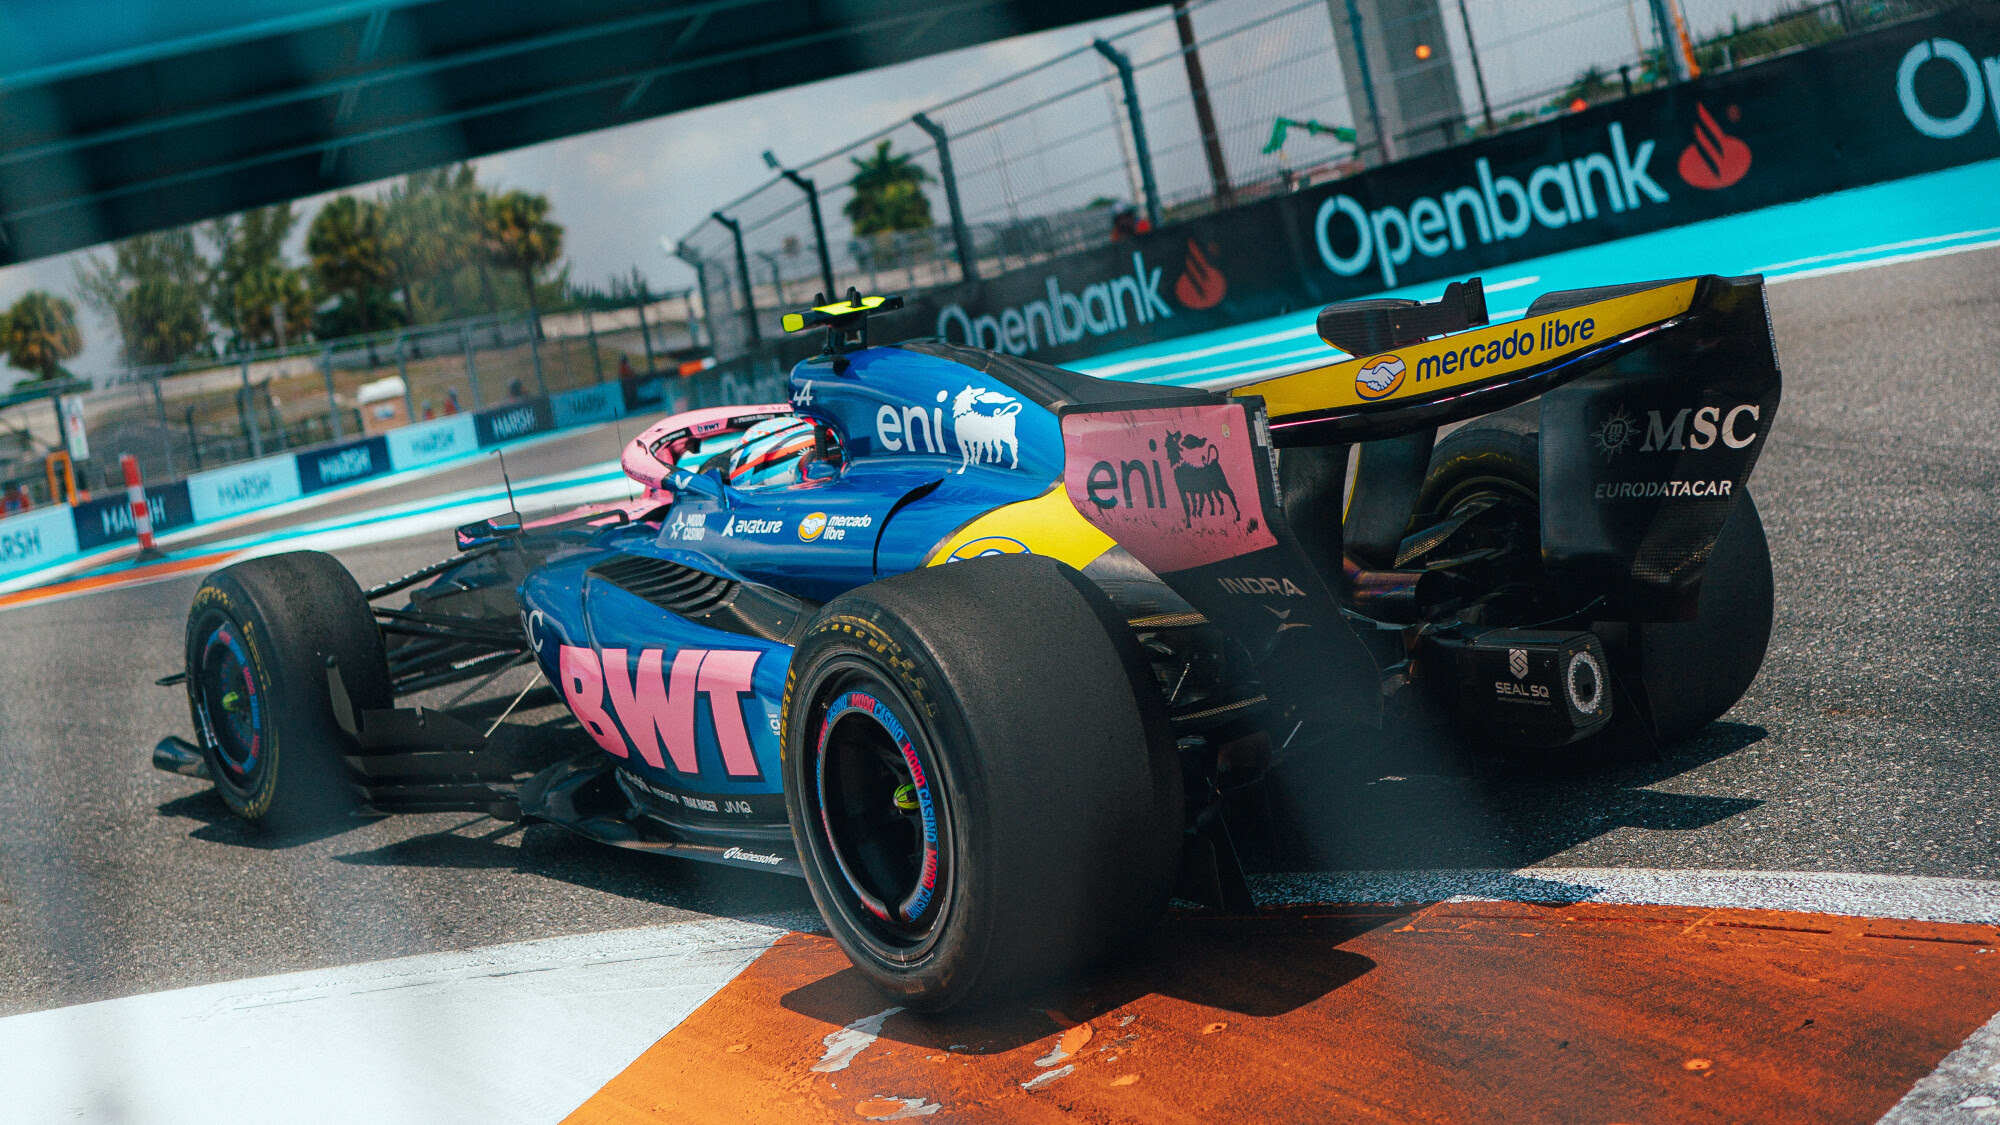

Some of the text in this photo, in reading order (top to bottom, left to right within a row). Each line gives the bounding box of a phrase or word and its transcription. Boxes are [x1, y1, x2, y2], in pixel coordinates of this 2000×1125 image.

[1315, 122, 1669, 287] Openbank
[1416, 316, 1595, 382] mercado libre
[491, 408, 539, 439] MARSH
[877, 389, 948, 454] eni
[1639, 405, 1759, 452] MSC
[318, 447, 373, 484] MARSH
[1087, 439, 1166, 509] eni
[1595, 480, 1732, 498] EURODATACAR
[735, 518, 783, 534] avature
[823, 527, 845, 540] libre
[827, 512, 872, 527] mercado
[1217, 577, 1306, 596] INDRA
[851, 693, 876, 713] MODO
[1495, 681, 1549, 698] SEAL SQ
[560, 645, 761, 775] BWT
[873, 702, 904, 742] CASINO
[902, 743, 926, 787] MODO
[919, 788, 937, 843] CASINO
[922, 848, 938, 889] MODO
